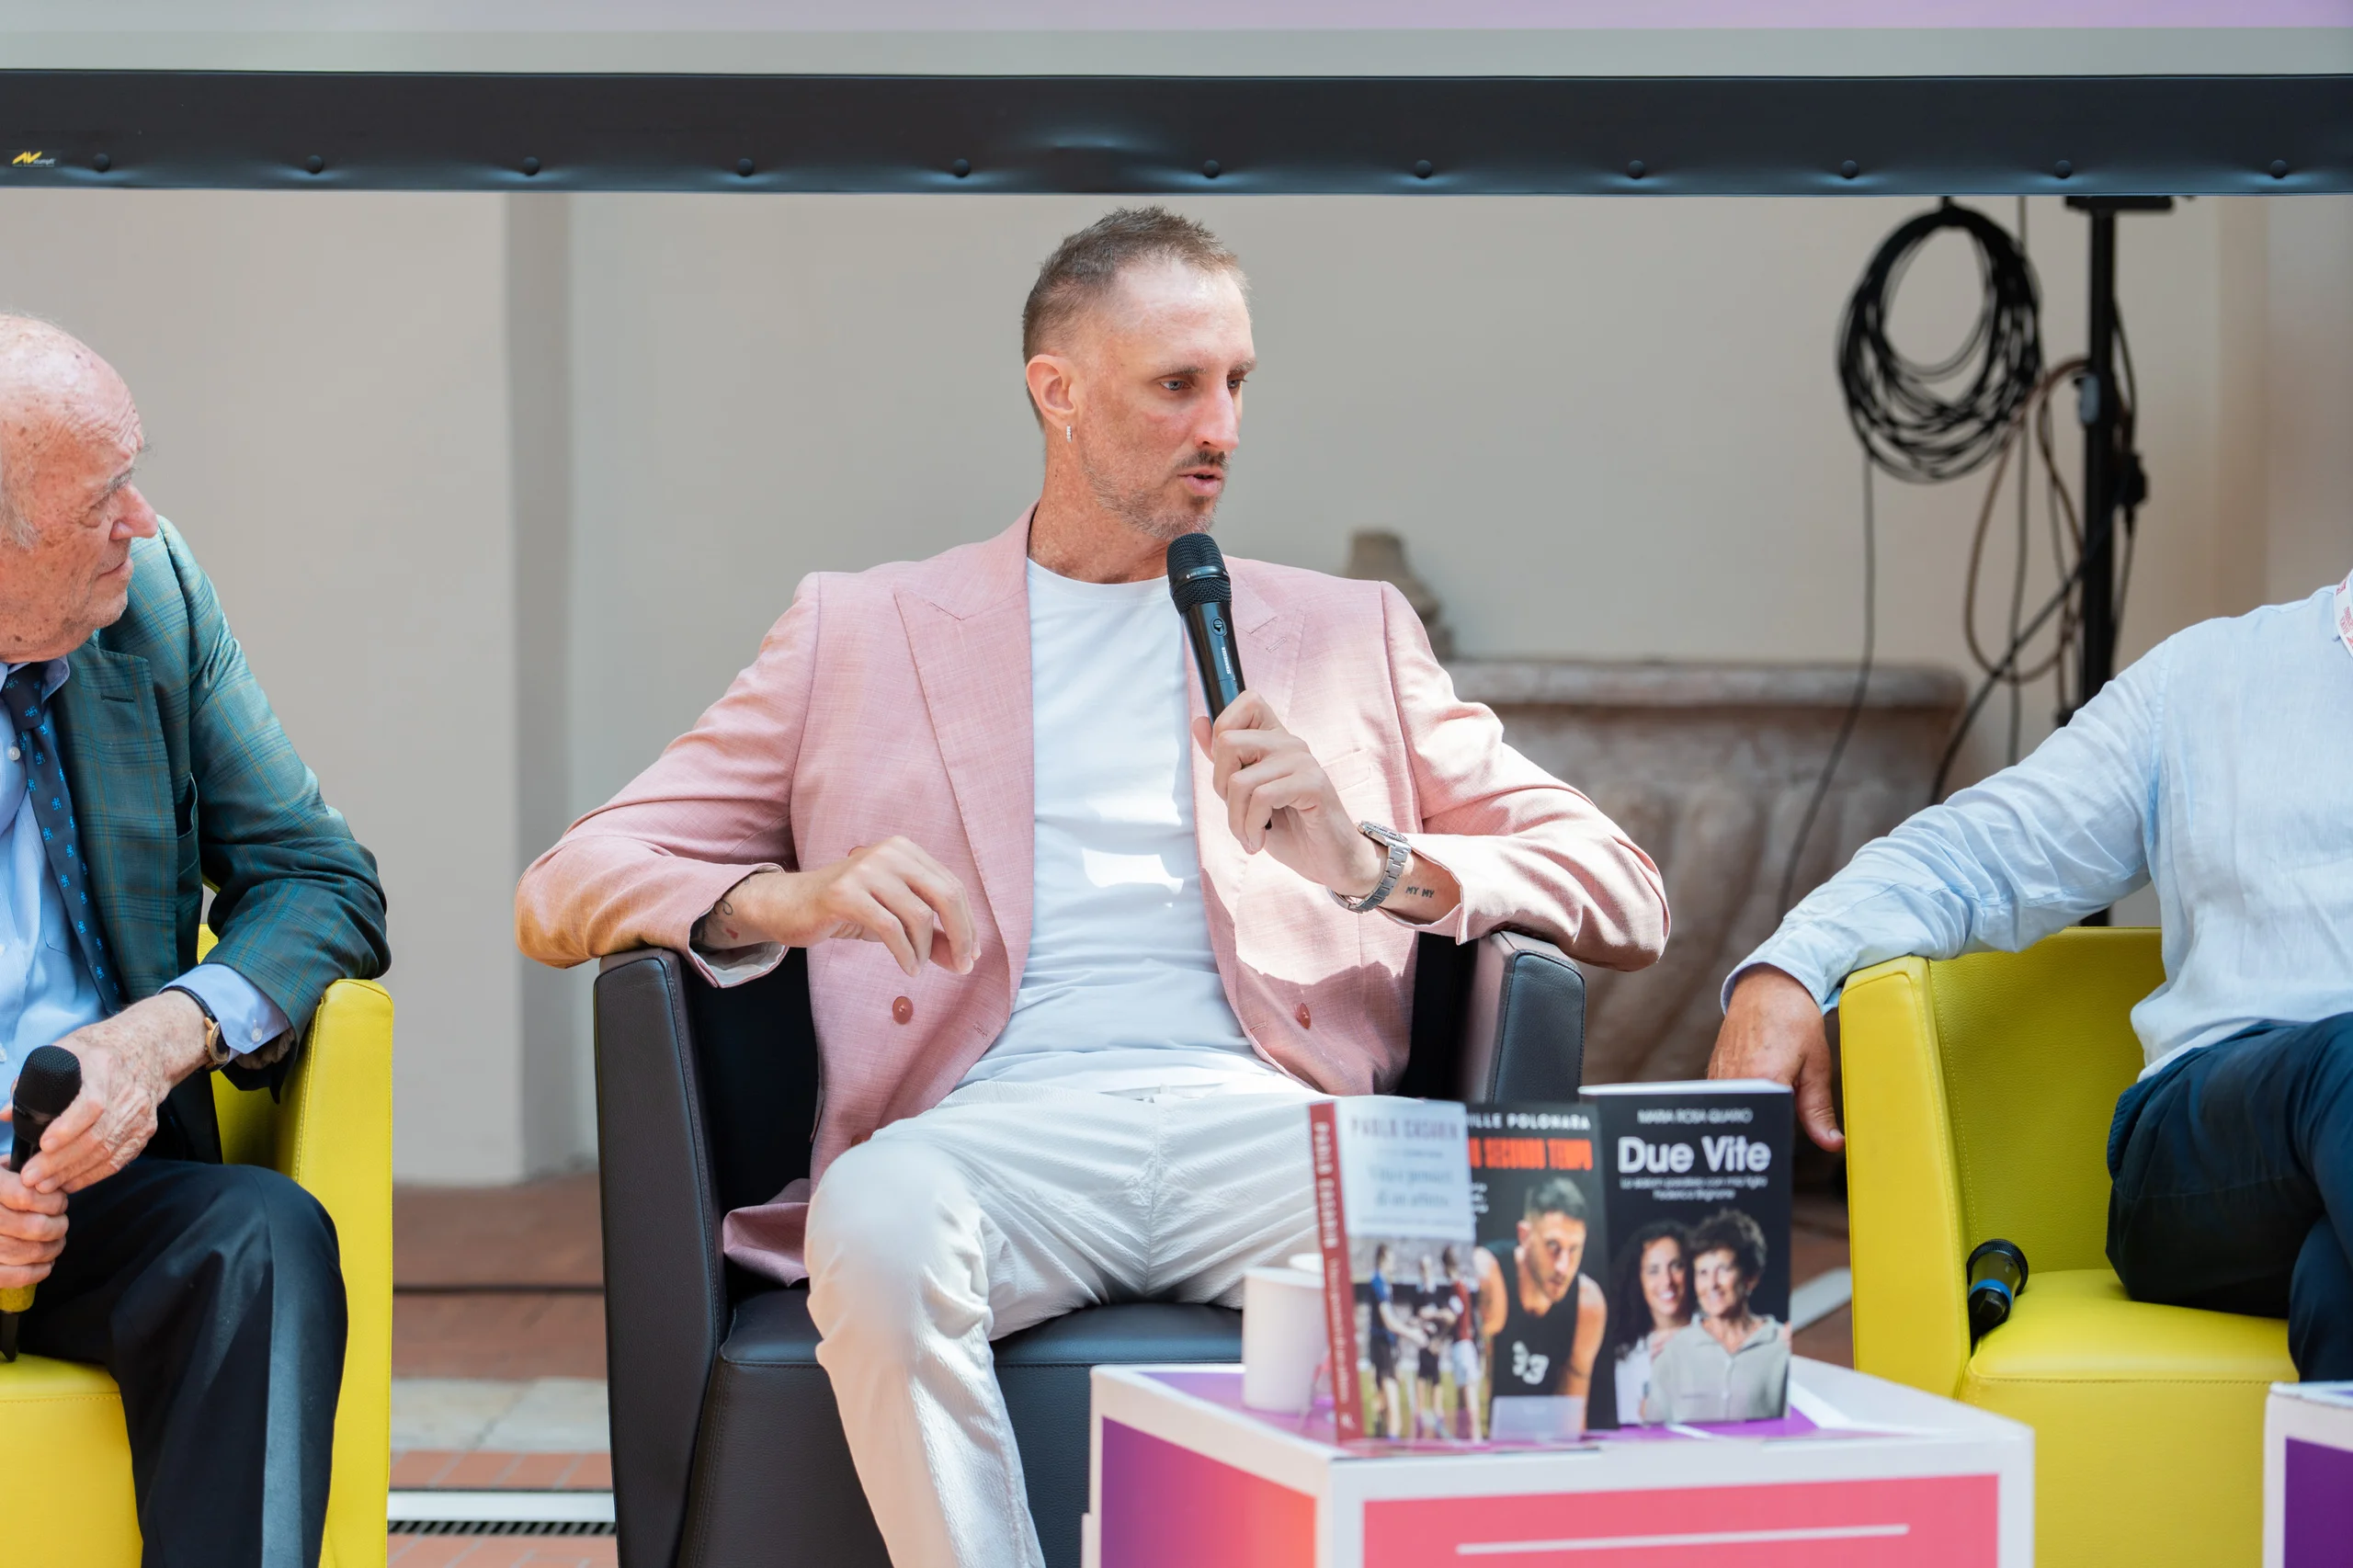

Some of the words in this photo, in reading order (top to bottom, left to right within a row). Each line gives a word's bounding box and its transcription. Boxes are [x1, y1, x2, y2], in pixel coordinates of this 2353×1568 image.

[1405, 885, 1419, 896] MY
[1421, 888, 1435, 898] MY
[1506, 1113, 1592, 1131] POLONARA
[1618, 1136, 1695, 1173] Due
[1701, 1135, 1772, 1172] Vite
